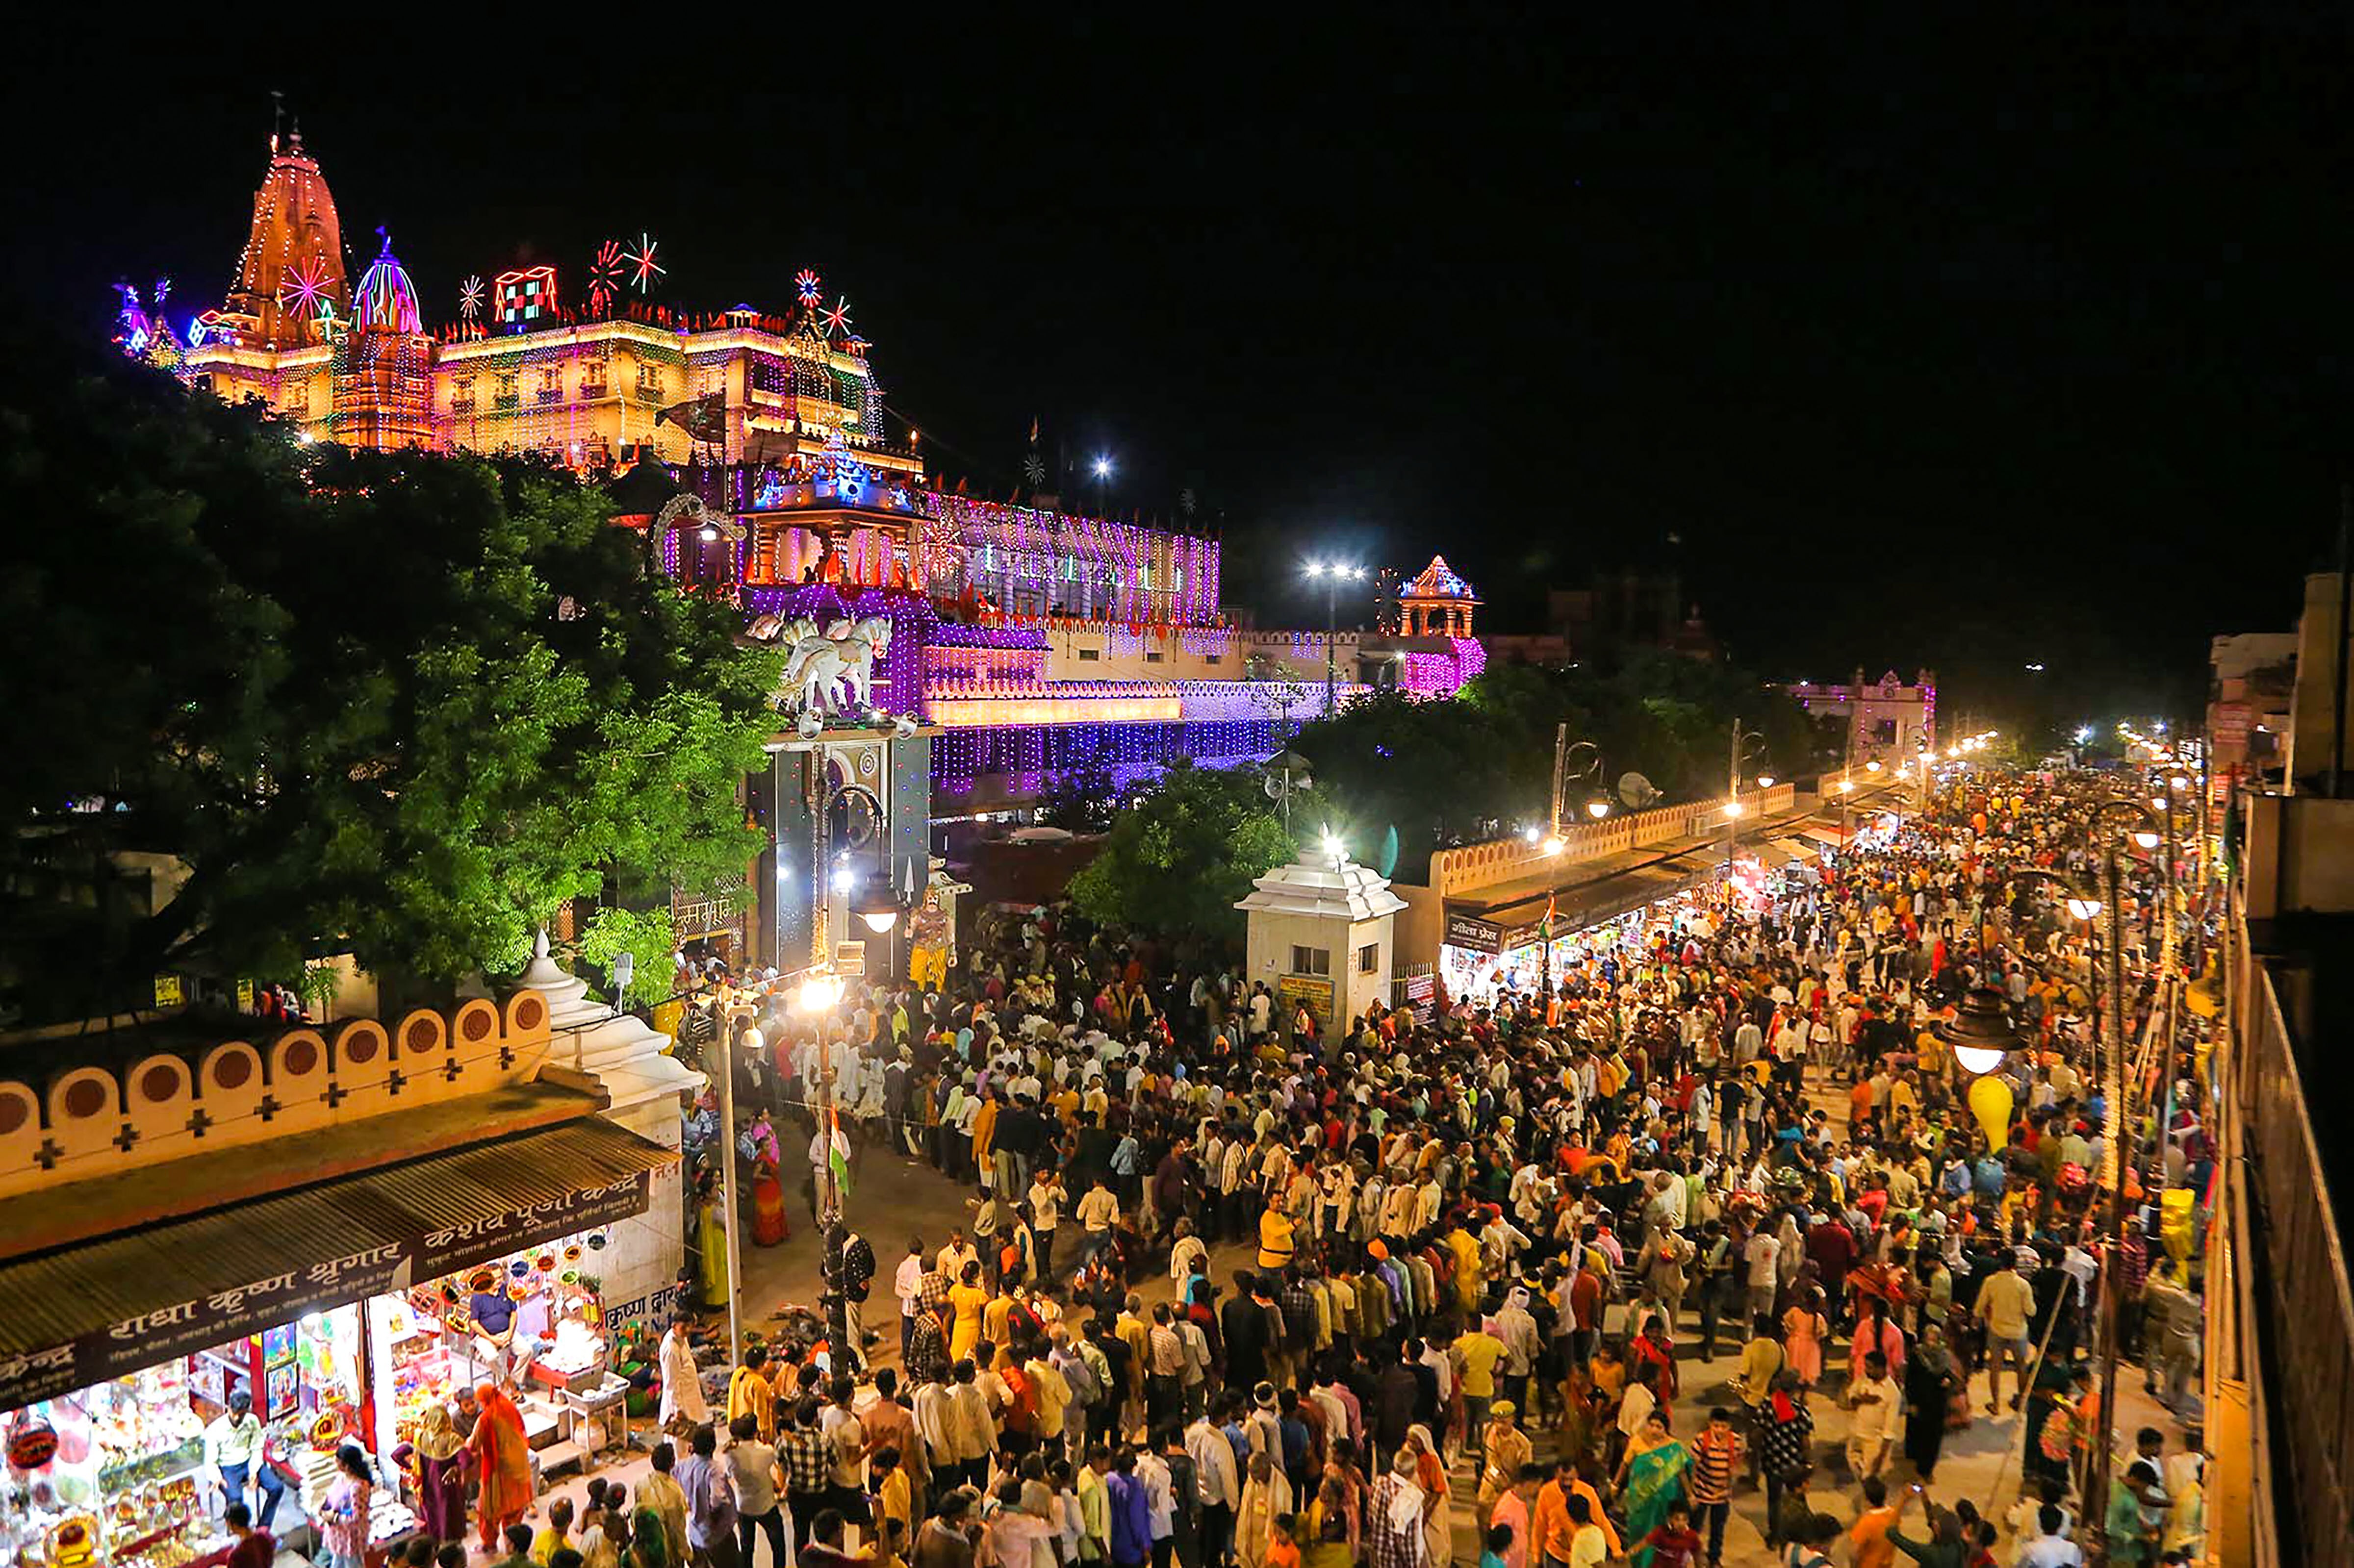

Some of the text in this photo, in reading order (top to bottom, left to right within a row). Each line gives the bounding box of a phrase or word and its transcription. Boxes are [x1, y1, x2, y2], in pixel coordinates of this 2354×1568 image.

[1452, 922, 1477, 937] गीता
[1479, 925, 1497, 941] प्रेस
[108, 1300, 197, 1339] राधा
[206, 1271, 297, 1314] कृष्ण
